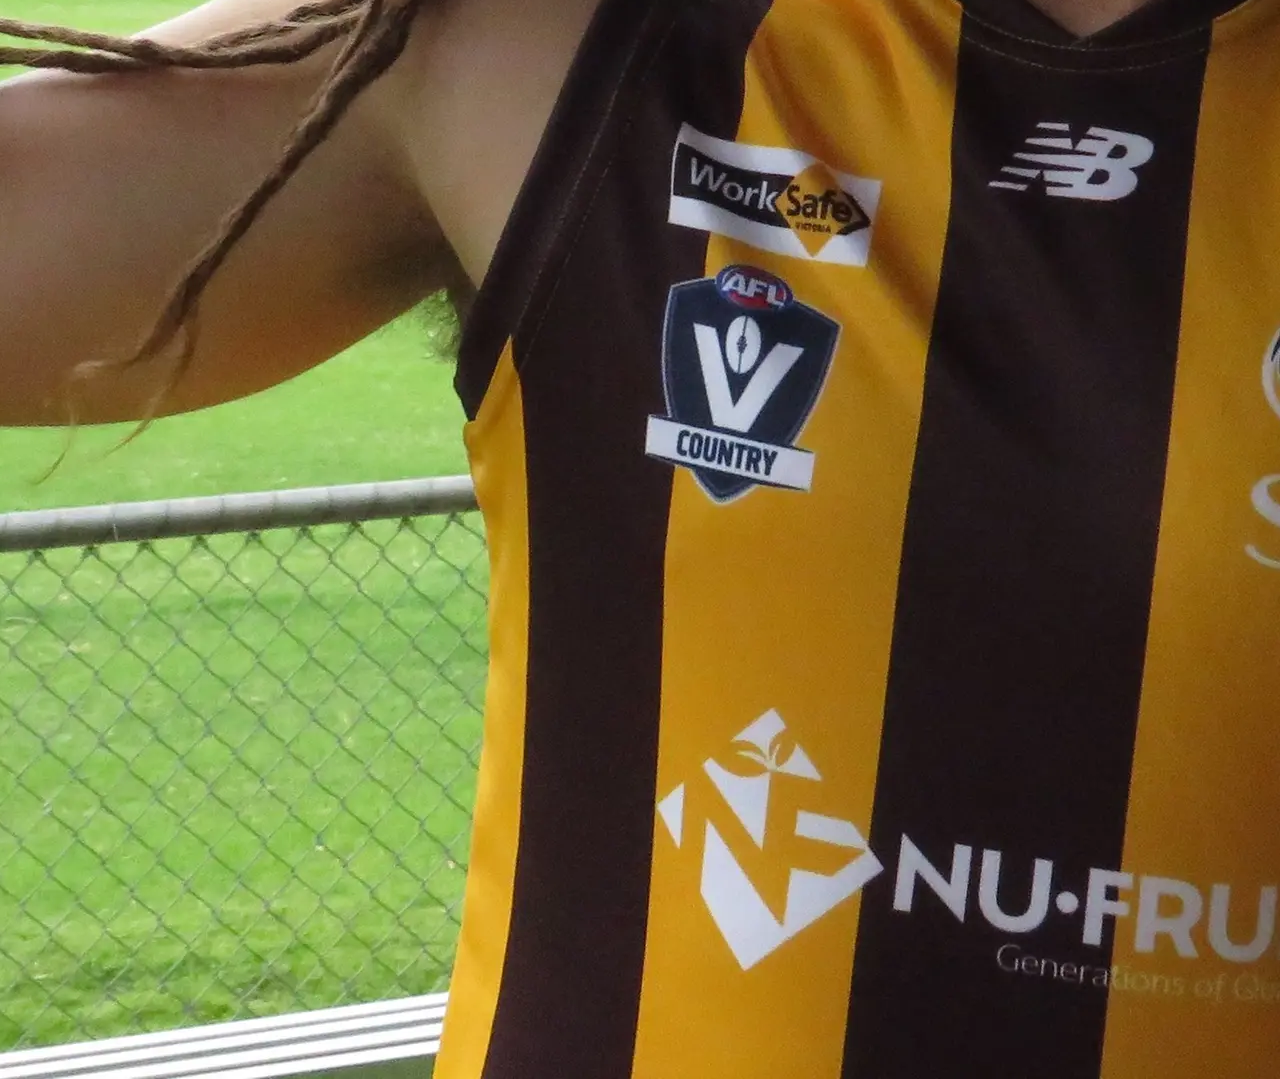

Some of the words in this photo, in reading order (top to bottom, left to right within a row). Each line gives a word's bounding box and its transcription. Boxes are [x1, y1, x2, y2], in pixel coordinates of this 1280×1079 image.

[722, 272, 787, 308] AFL
[676, 429, 778, 477] COUNTRY
[996, 944, 1185, 998] Generations
[1194, 972, 1227, 1002] of
